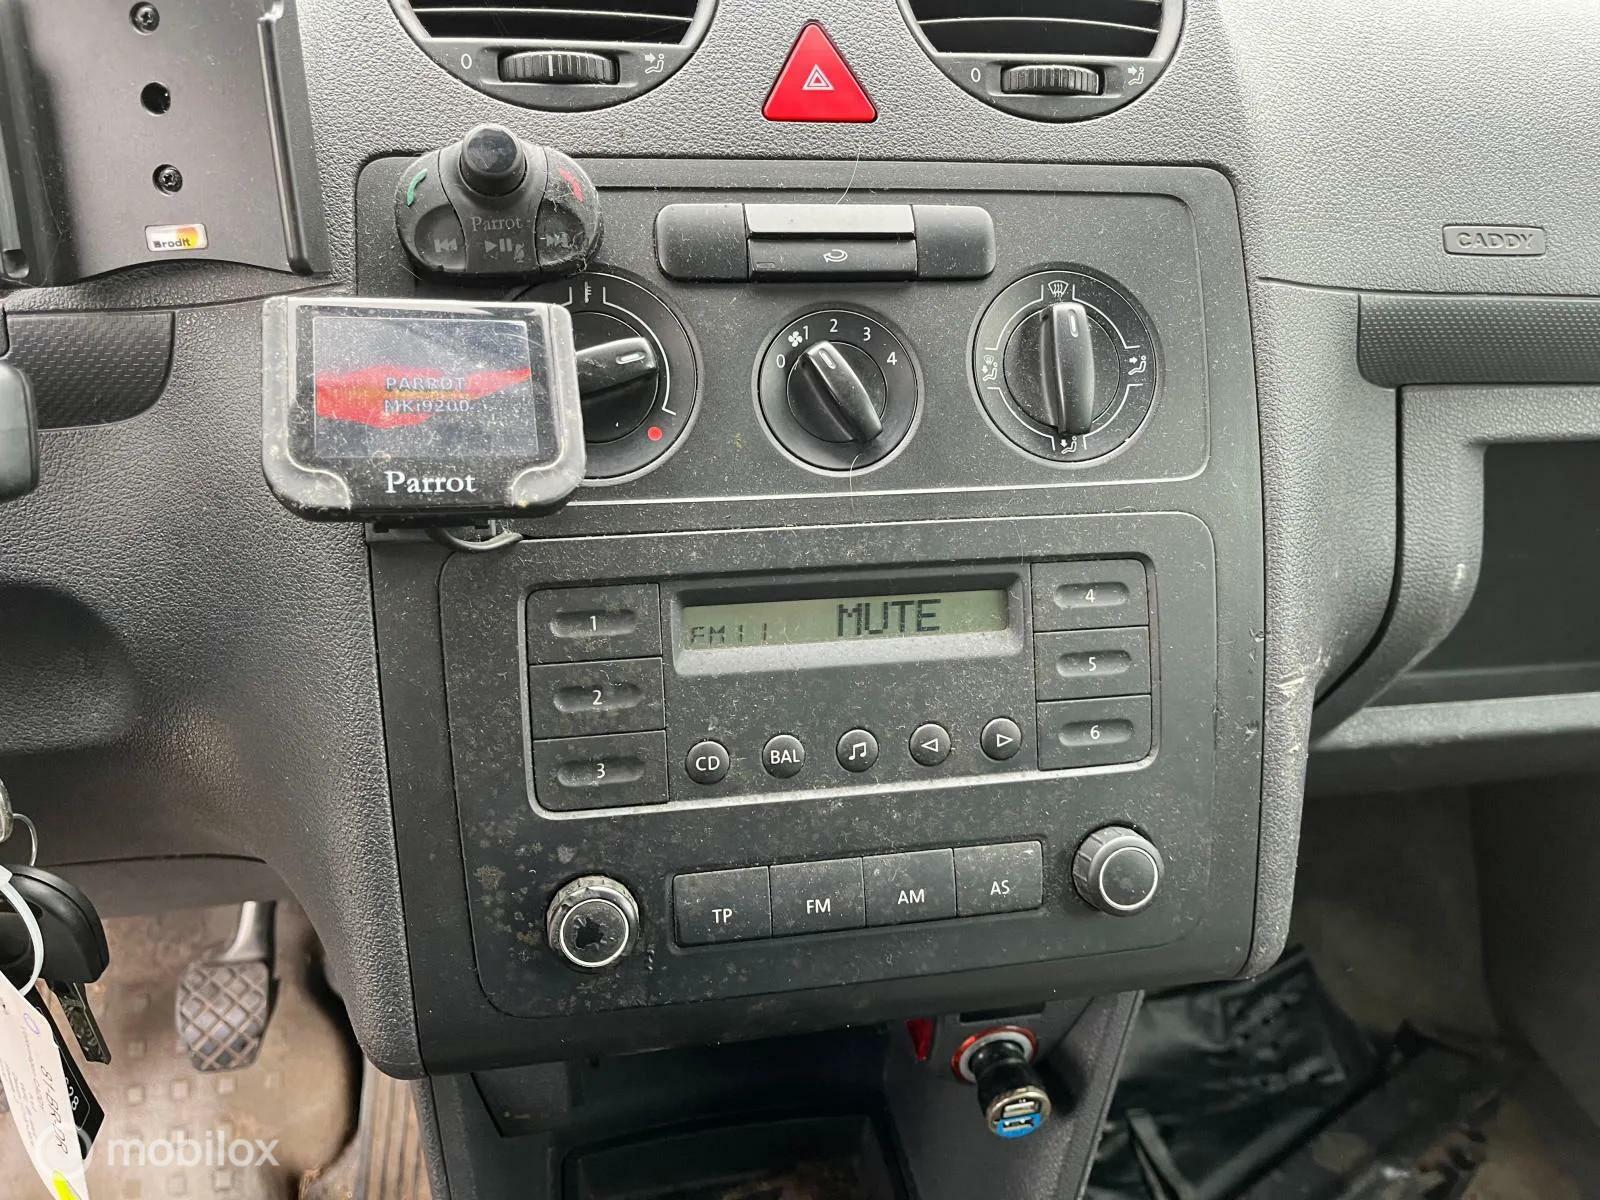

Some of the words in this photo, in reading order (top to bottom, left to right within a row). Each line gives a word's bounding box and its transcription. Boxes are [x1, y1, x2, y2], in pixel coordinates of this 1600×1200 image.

[470, 216, 523, 232] Parrot
[1457, 231, 1533, 249] CADDY
[776, 353, 786, 368] 0
[802, 325, 809, 340] 1
[829, 318, 839, 333] 2
[863, 326, 872, 341] 3
[886, 351, 898, 366] 4
[386, 377, 465, 390] PARROT
[384, 400, 470, 413] MKi9200
[384, 470, 478, 494] Parrot
[1085, 588, 1096, 603] 4
[589, 615, 597, 632] 1
[838, 598, 942, 637] MUTE
[1088, 656, 1097, 671] 5
[592, 690, 603, 705] 2
[1090, 724, 1101, 740] 6
[695, 755, 721, 772] CD
[770, 748, 800, 765] BAL
[596, 763, 606, 779] 3
[990, 880, 1011, 896] AS
[898, 888, 925, 905] AM
[806, 899, 831, 915] FM
[712, 908, 733, 924] TP
